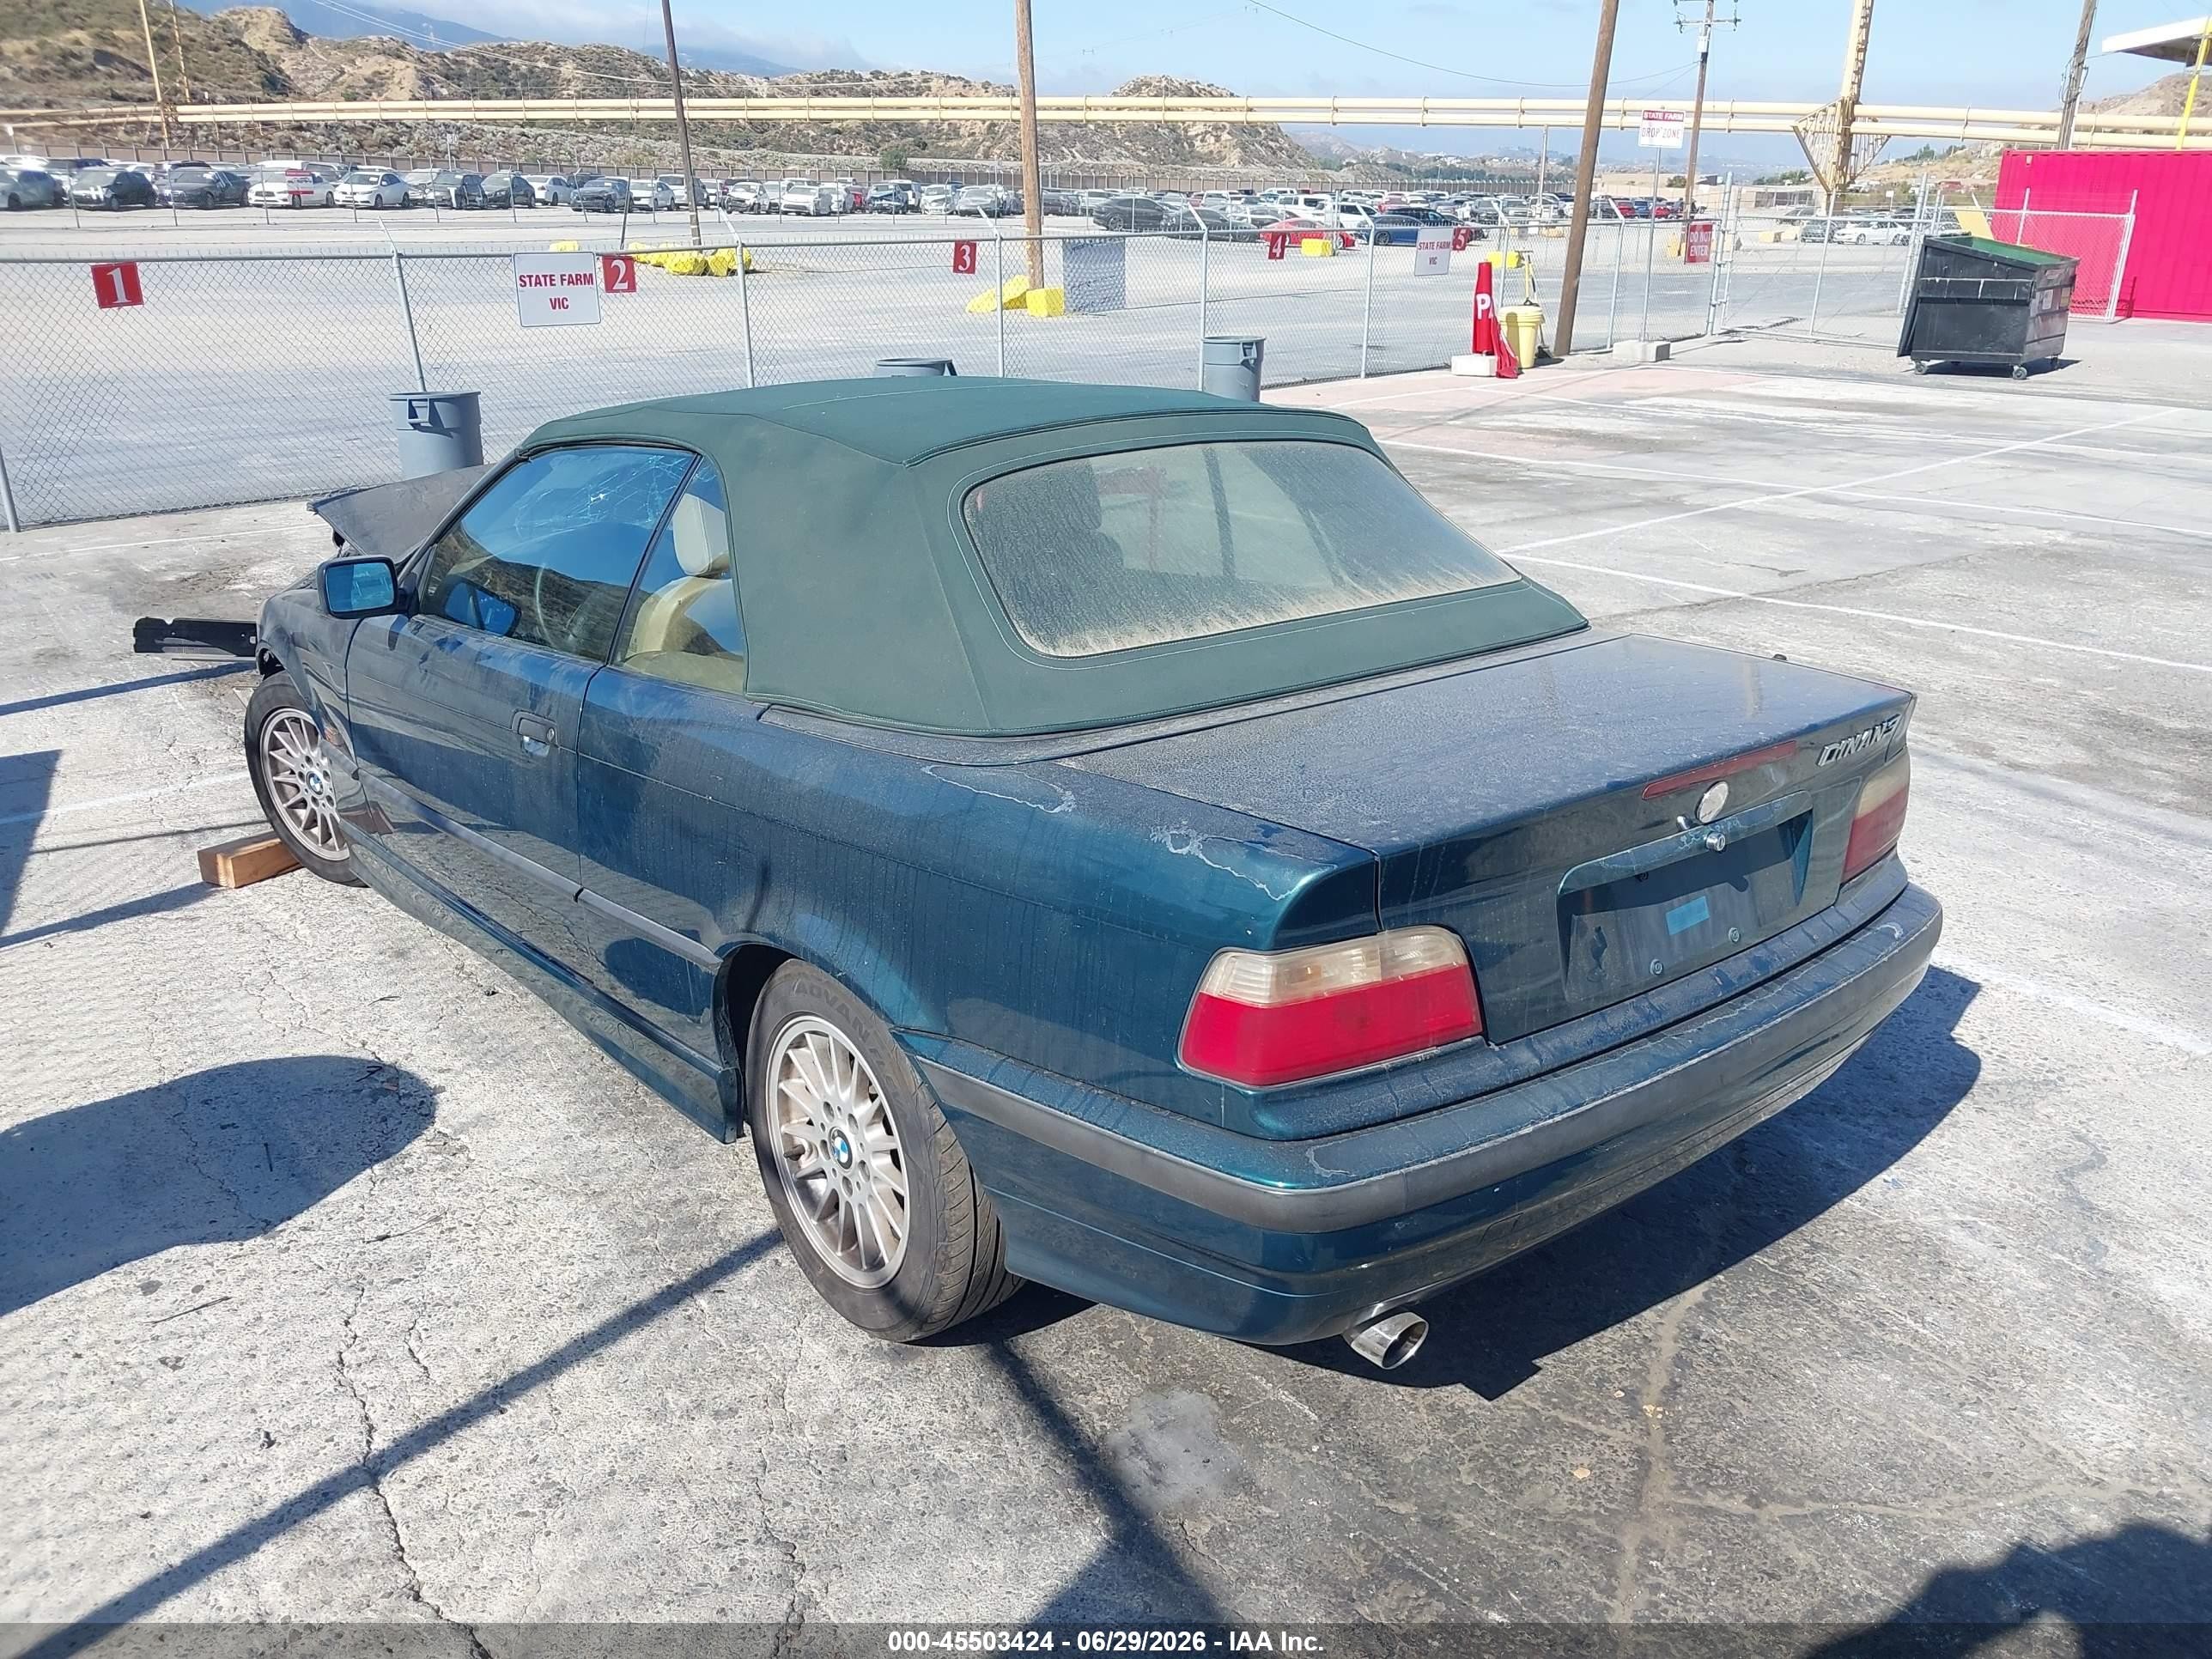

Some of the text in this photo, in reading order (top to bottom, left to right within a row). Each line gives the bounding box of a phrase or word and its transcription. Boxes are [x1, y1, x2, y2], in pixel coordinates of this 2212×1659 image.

[1641, 127, 1680, 138] DROP ZONE
[1455, 228, 1466, 249] 5
[1690, 232, 1711, 242] DO NOT
[1272, 234, 1282, 258] 4
[1418, 240, 1451, 250] STATE FARM
[1690, 245, 1710, 256] ENTER
[958, 245, 970, 270] 3
[519, 273, 593, 288] STATE FARM
[611, 259, 629, 289] 2
[106, 267, 132, 303] 1
[549, 297, 569, 310] VIC
